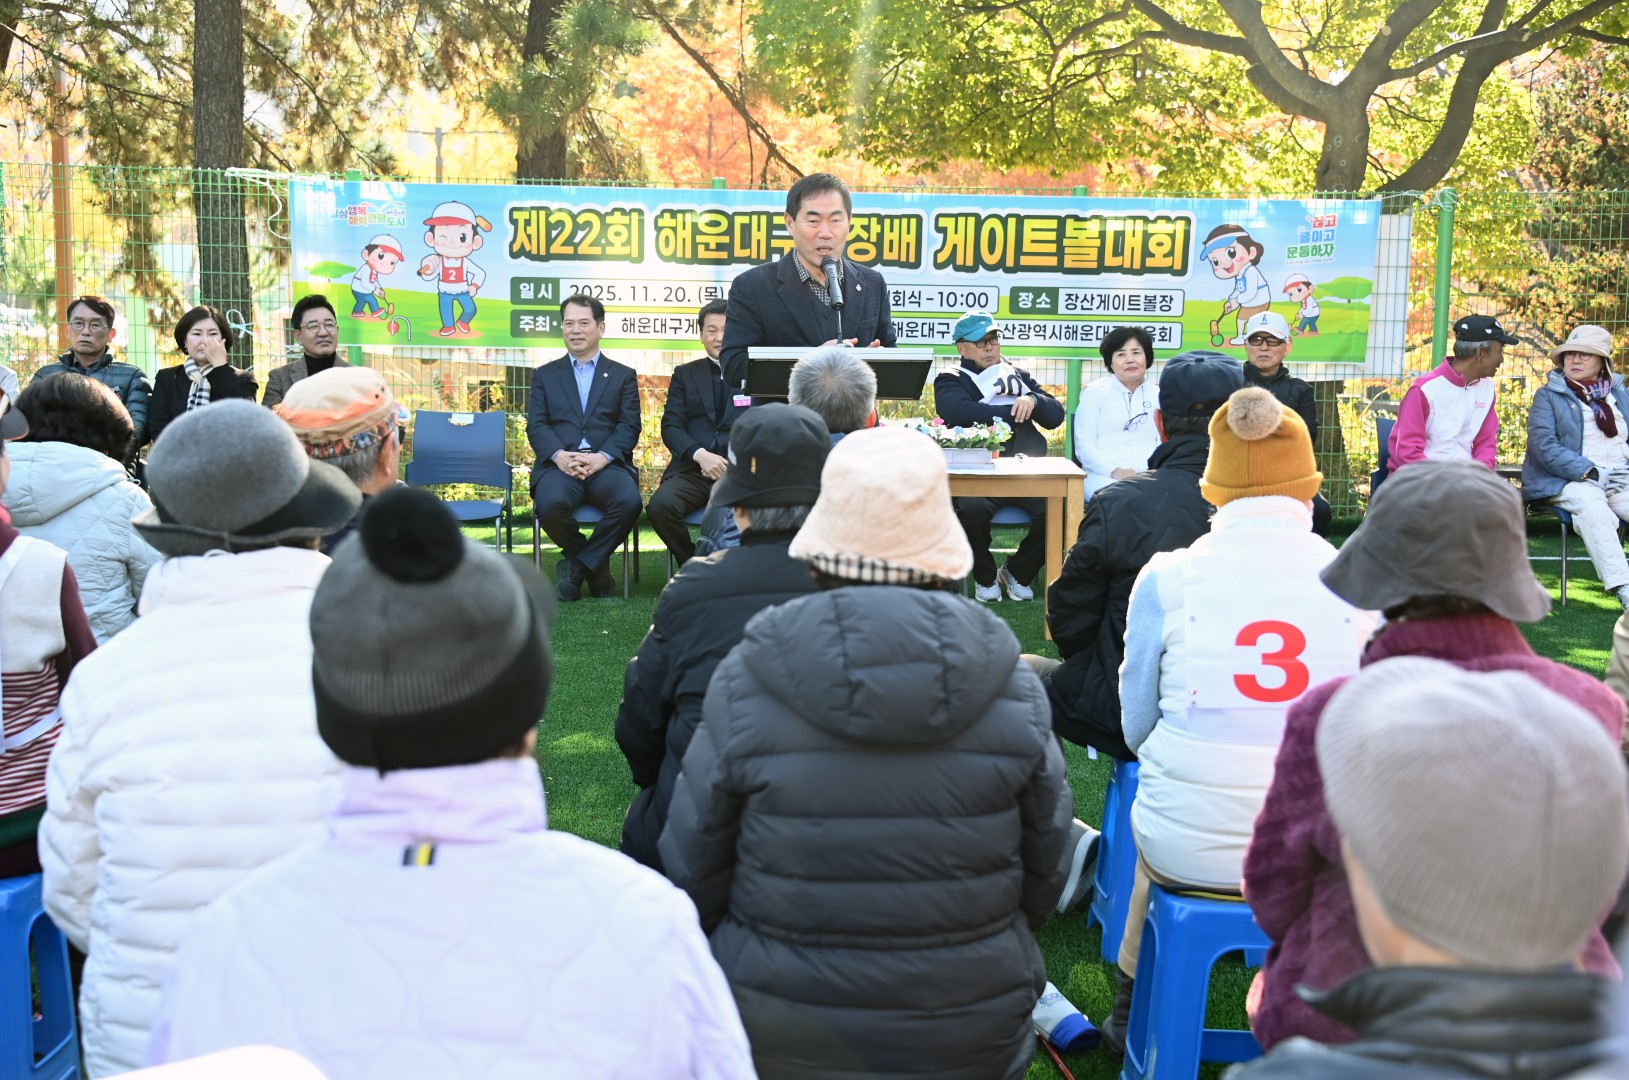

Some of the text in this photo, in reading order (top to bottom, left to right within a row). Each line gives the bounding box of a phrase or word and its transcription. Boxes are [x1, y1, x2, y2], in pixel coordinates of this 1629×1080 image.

[512, 210, 1186, 270] 제22회 해운대구장배 게이트볼대회
[1286, 243, 1335, 259] 운동하자
[448, 270, 456, 280] 2
[519, 282, 553, 300] 일시
[569, 284, 622, 301] 2025.
[629, 286, 657, 302] 11.
[663, 286, 691, 303] 20.
[698, 286, 725, 301] (목)
[1018, 291, 1174, 313] 장소 장산게이트볼장
[519, 315, 1172, 343] 주최· 해운대구게 해운대구 산광역시해운대육회
[993, 374, 1022, 396] 10
[1233, 620, 1310, 703] 3
